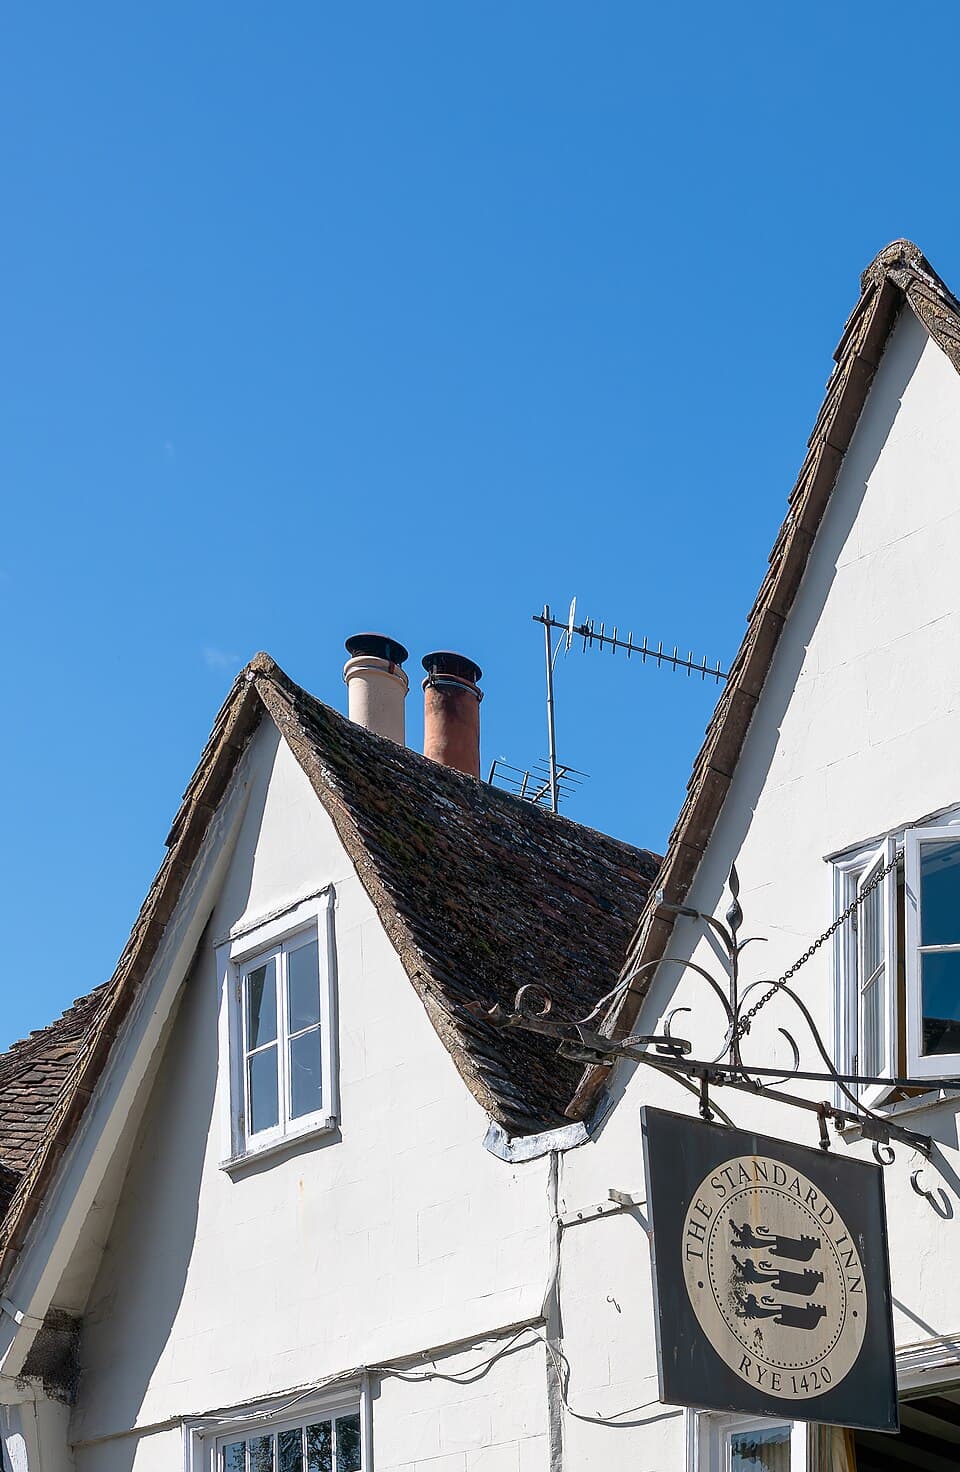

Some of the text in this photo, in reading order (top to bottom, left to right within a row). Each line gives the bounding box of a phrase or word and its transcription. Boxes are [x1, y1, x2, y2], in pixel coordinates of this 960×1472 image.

[687, 1161, 863, 1294] THE STANDARD INN
[739, 1354, 832, 1394] RYE 1420
